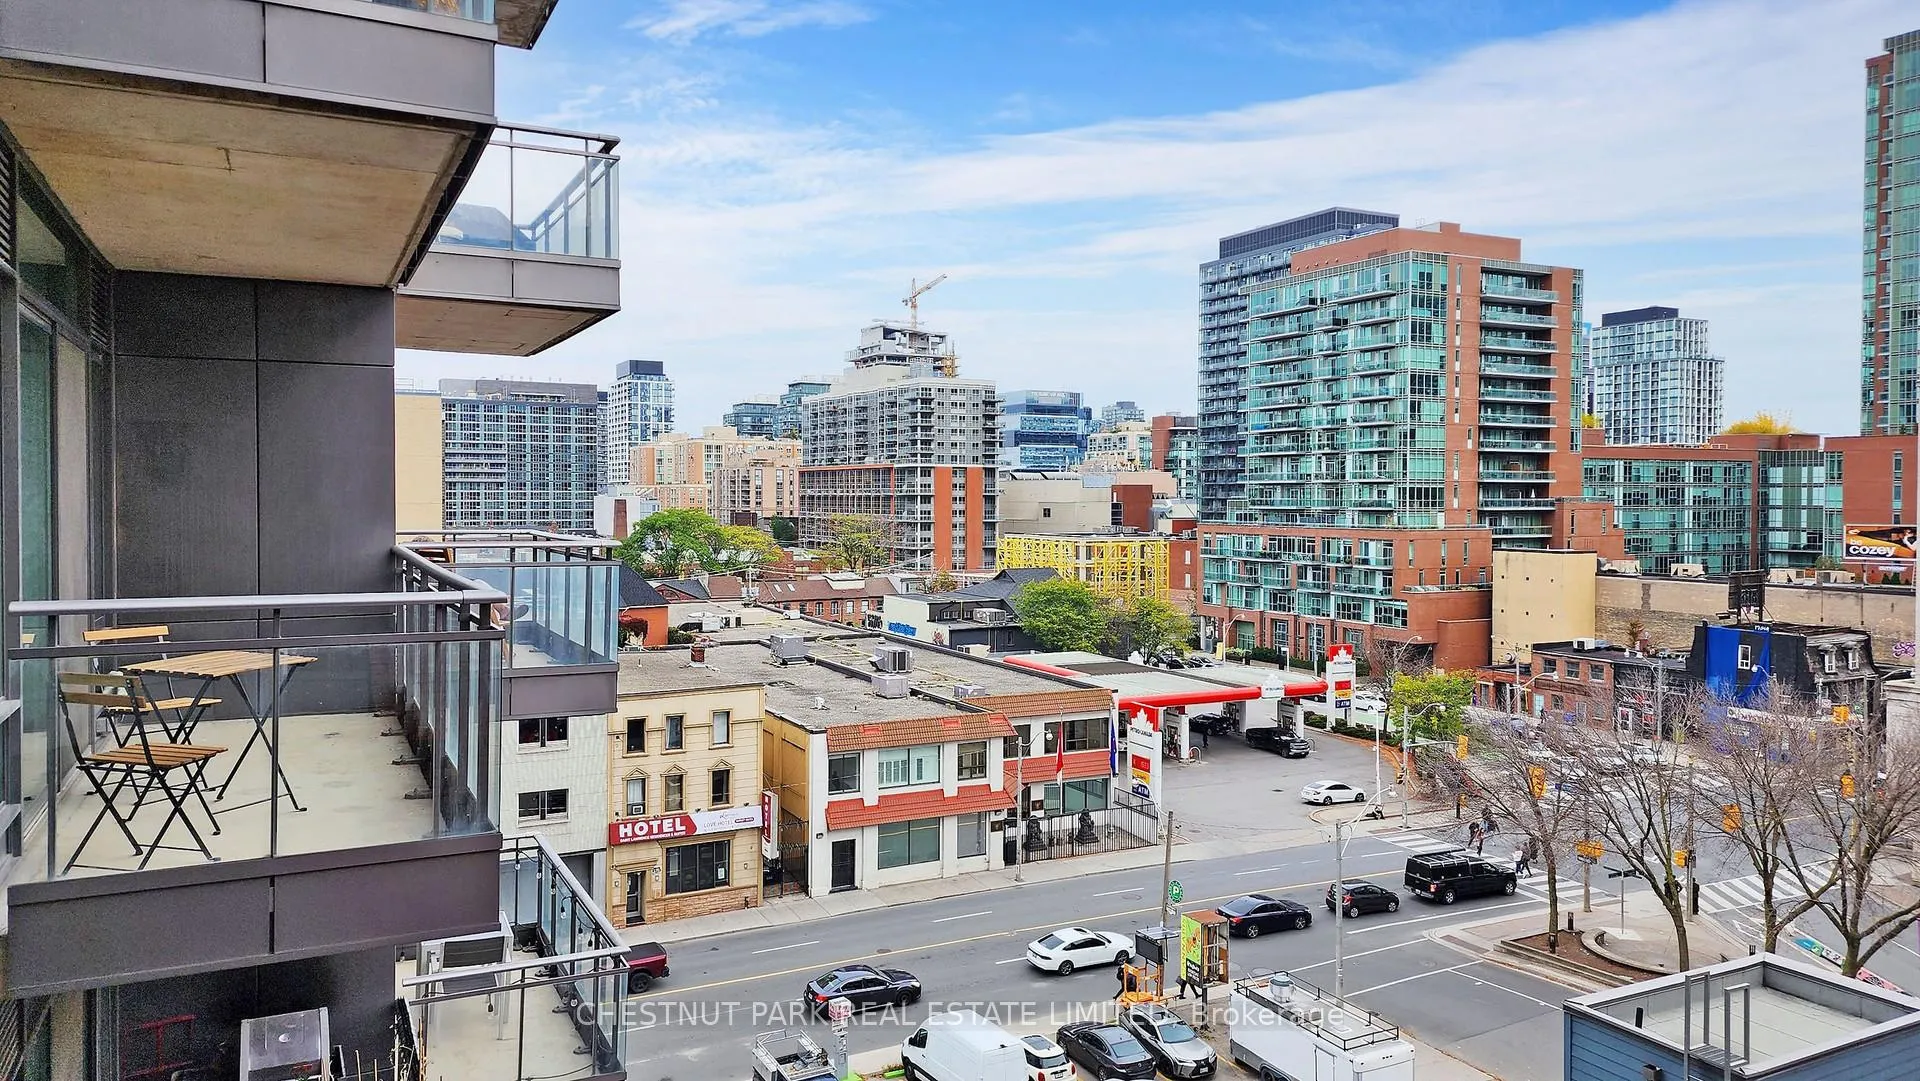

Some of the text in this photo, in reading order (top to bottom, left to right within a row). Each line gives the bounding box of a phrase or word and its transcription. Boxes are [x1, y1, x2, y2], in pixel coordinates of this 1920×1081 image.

[1849, 545, 1896, 557] cozey
[1138, 786, 1149, 796] ATM
[619, 817, 686, 838] HOTEL
